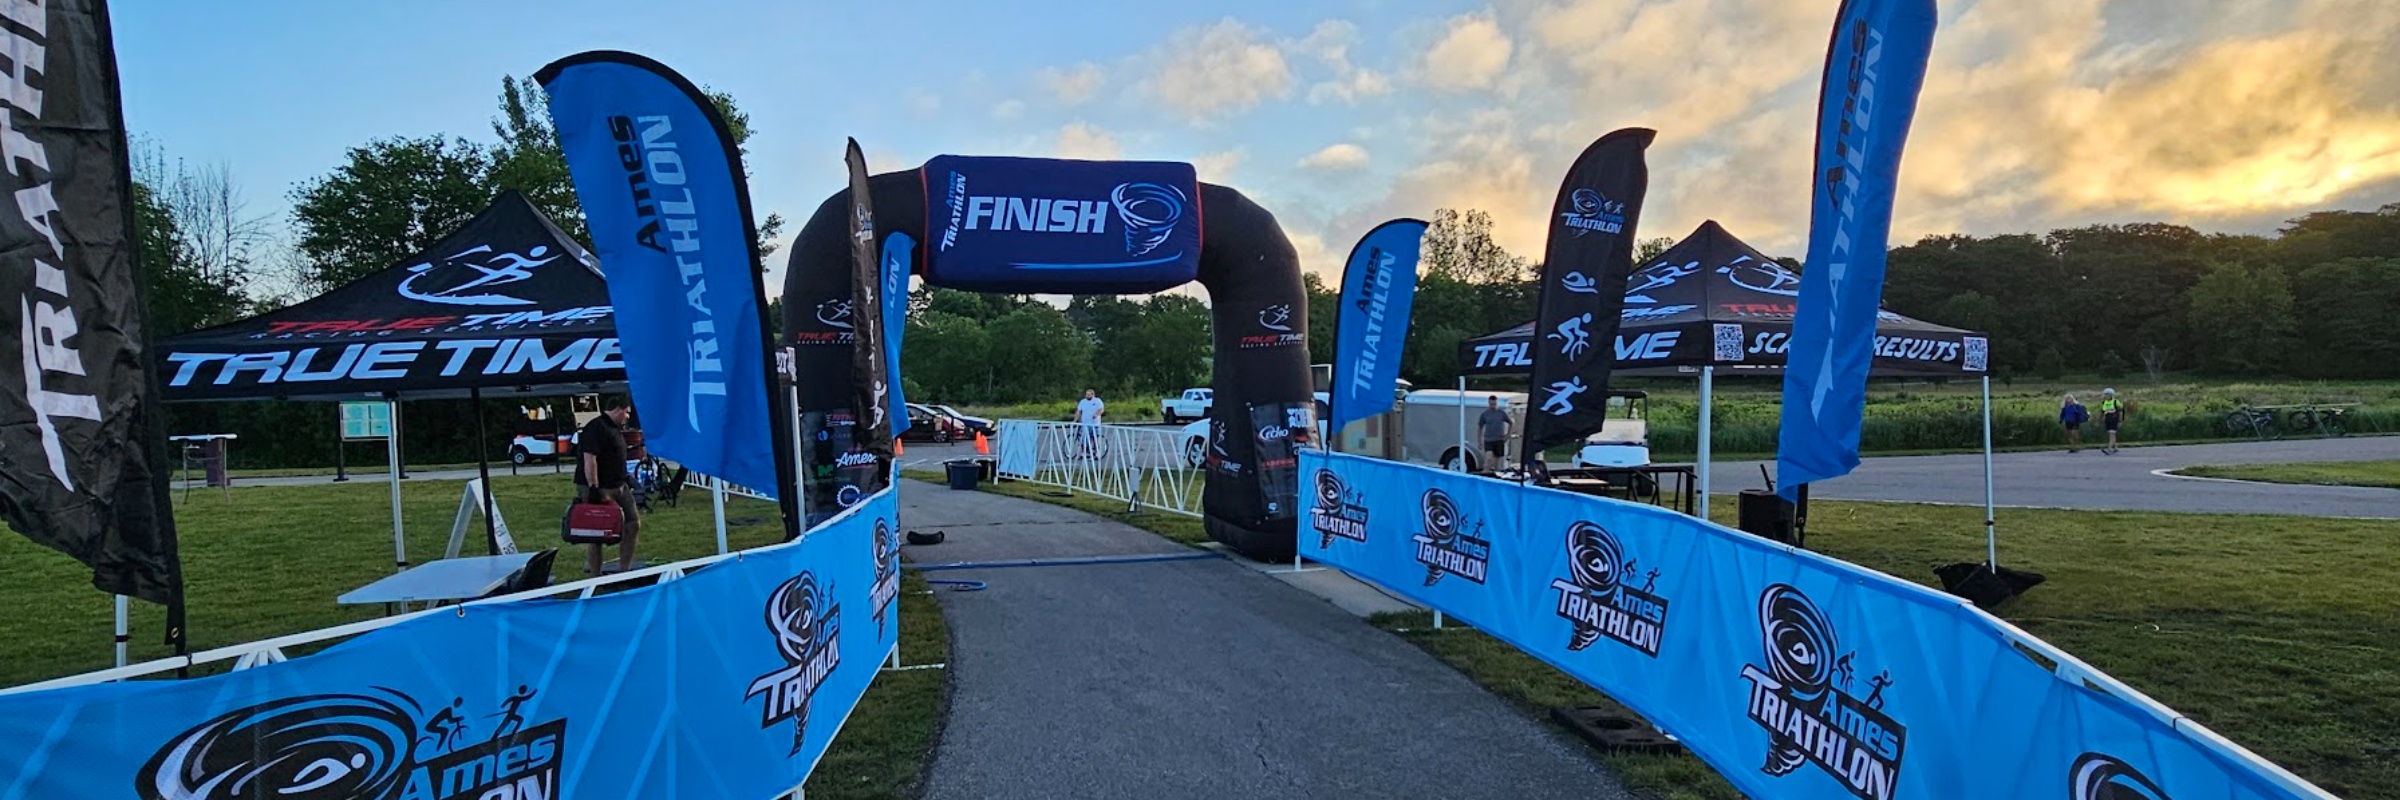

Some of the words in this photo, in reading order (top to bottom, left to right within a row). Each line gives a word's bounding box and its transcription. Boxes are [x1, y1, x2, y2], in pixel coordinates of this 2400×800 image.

[1826, 17, 1868, 211] Ames
[607, 115, 667, 253] Ames
[941, 174, 966, 252] TRIATHLON
[964, 196, 1109, 233] FINISH
[1561, 212, 1622, 234] TRIATHLON
[638, 114, 727, 433] TRIATHLON
[1356, 246, 1381, 316] Ames
[267, 316, 460, 332] TRUE
[460, 306, 613, 326] TIME
[1352, 252, 1397, 400] TRIATHLON
[1872, 336, 1962, 362] RESULTS
[167, 341, 427, 386] TRUE
[435, 338, 624, 377] TIME
[1311, 507, 1366, 540] TRIATHLON
[1412, 534, 1486, 581] TRIATHLON
[1452, 534, 1488, 560] Ames
[1552, 580, 1660, 653] TRIATHLON
[1611, 585, 1664, 623] Ames
[747, 634, 839, 720] TRIATHLON
[1742, 665, 1895, 800] TRIATHLON
[1819, 689, 1899, 761] Ames
[400, 734, 557, 800] Ames
